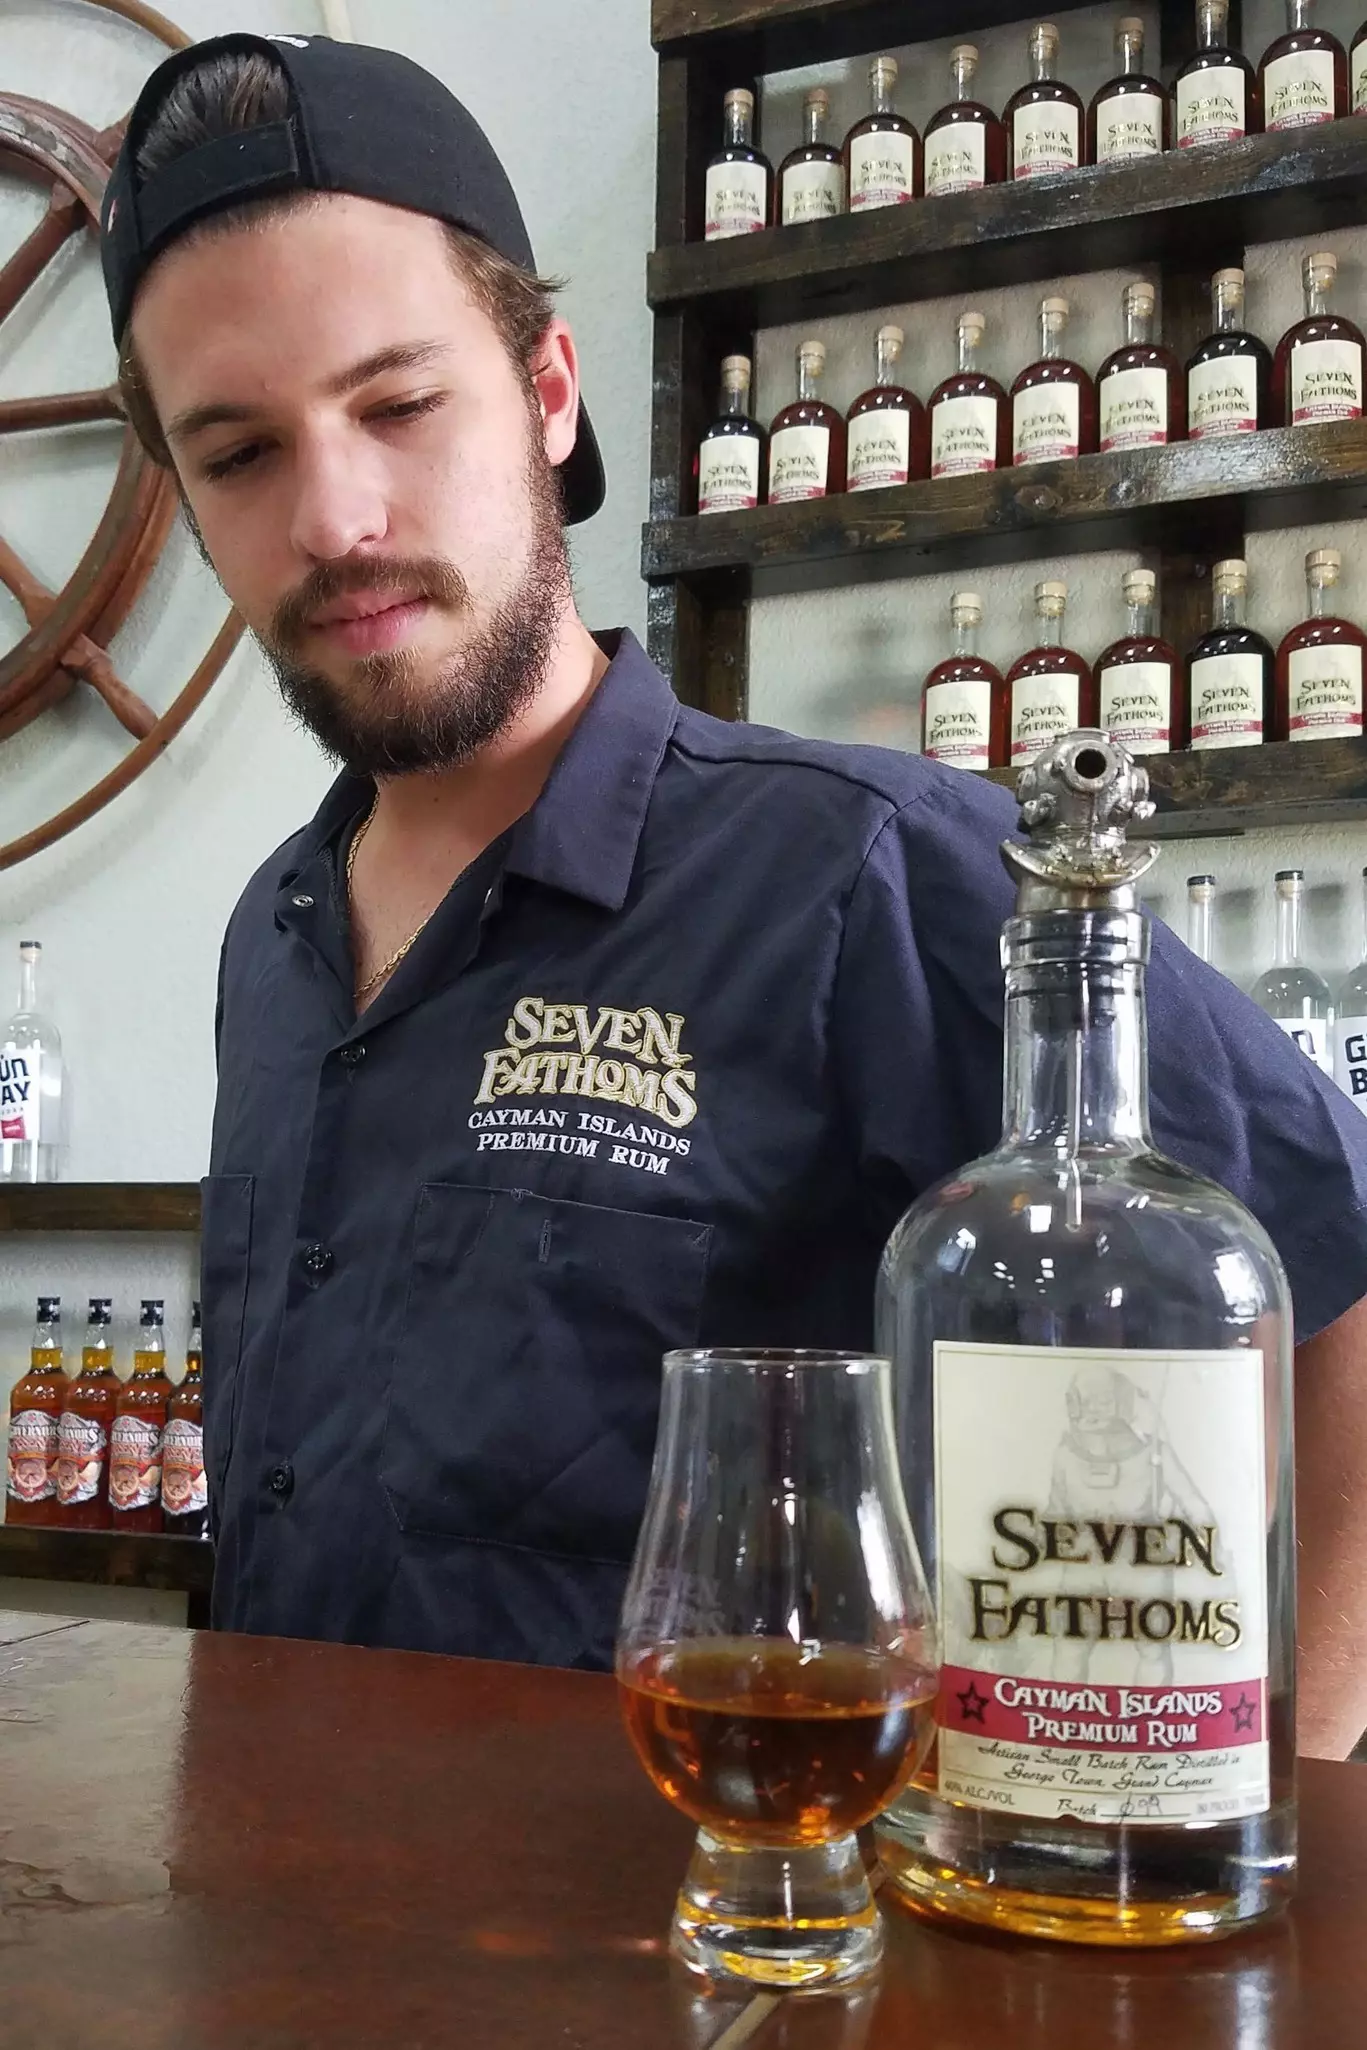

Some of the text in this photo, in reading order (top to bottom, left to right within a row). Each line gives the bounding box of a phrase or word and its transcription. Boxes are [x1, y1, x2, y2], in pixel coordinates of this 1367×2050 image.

[1305, 372, 1354, 386] SEVEN
[1202, 686, 1250, 702] SEVEN
[1301, 678, 1352, 695] SEVEN
[1021, 705, 1066, 721] SEVEN
[1111, 695, 1159, 710] SEVEN
[934, 713, 977, 728] SEVEN
[1106, 710, 1163, 726] FATHOMS
[505, 997, 692, 1068] SEVEN
[473, 1046, 698, 1129] FATHOMS
[468, 1108, 692, 1156] CAYMAN ISLANDS
[477, 1131, 671, 1176] PREMIUM RUM
[991, 1507, 1223, 1576] SEVEN
[968, 1577, 1242, 1651] FATHOMS
[994, 1678, 1222, 1719] CAYMAN ISLANDS
[1022, 1711, 1198, 1748] PREMIUM RUM
[1035, 1749, 1082, 1767] Small
[1087, 1753, 1127, 1770] Batch
[1135, 1755, 1168, 1771] Rum
[1004, 1762, 1055, 1785] George
[1112, 1771, 1160, 1790] Grand
